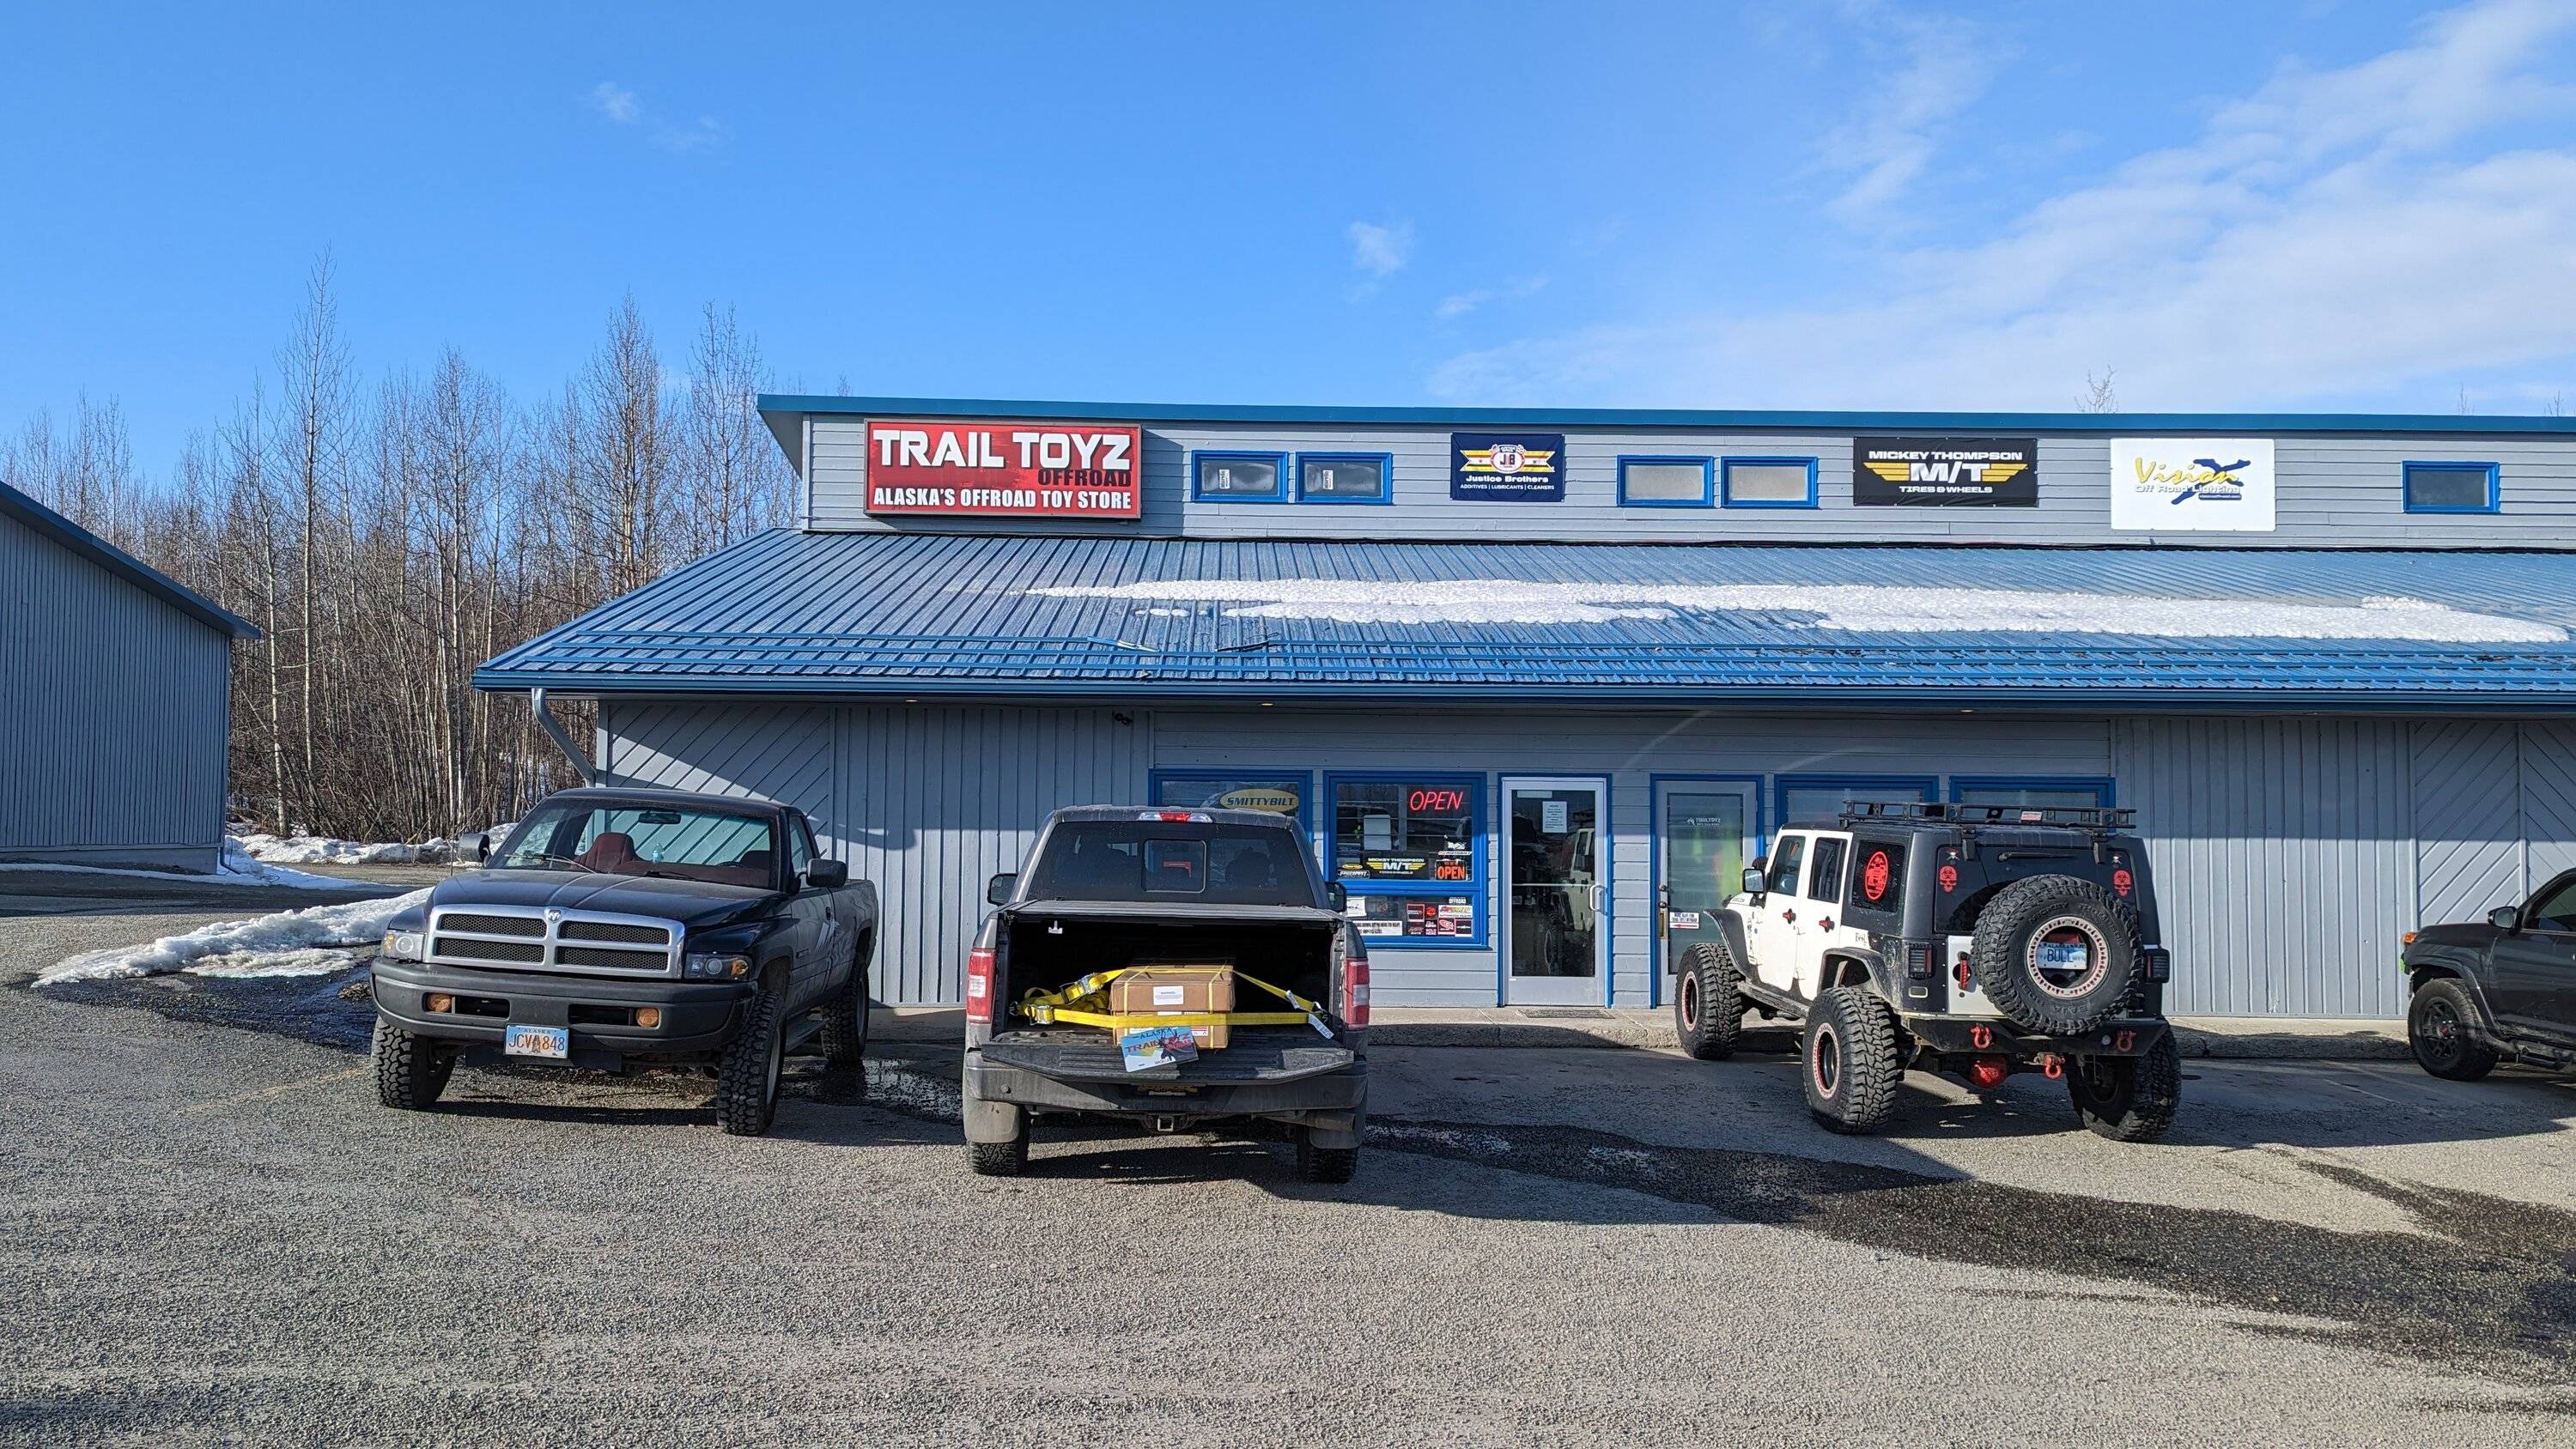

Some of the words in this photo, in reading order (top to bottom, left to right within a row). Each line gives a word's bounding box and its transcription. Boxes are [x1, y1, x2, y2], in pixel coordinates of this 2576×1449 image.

[872, 429, 1005, 468] TRAIL
[1012, 433, 1131, 470] TOYZ
[1868, 451, 1929, 459] MICKEY
[1932, 451, 2023, 461] THOMPSON
[1910, 461, 1990, 483] M/T
[2135, 458, 2239, 483] Vision
[1037, 470, 1132, 488] OFFROAD
[2135, 484, 2155, 493] Off
[873, 487, 955, 506] ALASKA'S
[960, 488, 1036, 508] OFFROAD
[1042, 490, 1072, 508] TOY
[1078, 491, 1132, 509] STORE
[1227, 797, 1295, 806] SMITTYBILT
[1410, 791, 1463, 810] OPEN
[1383, 862, 1412, 870] M/T
[1437, 866, 1465, 880] OPEN
[2047, 949, 2074, 962] BULL
[1139, 1028, 1173, 1039] ALASKA
[508, 1033, 532, 1048] JCV
[542, 1035, 565, 1052] 848
